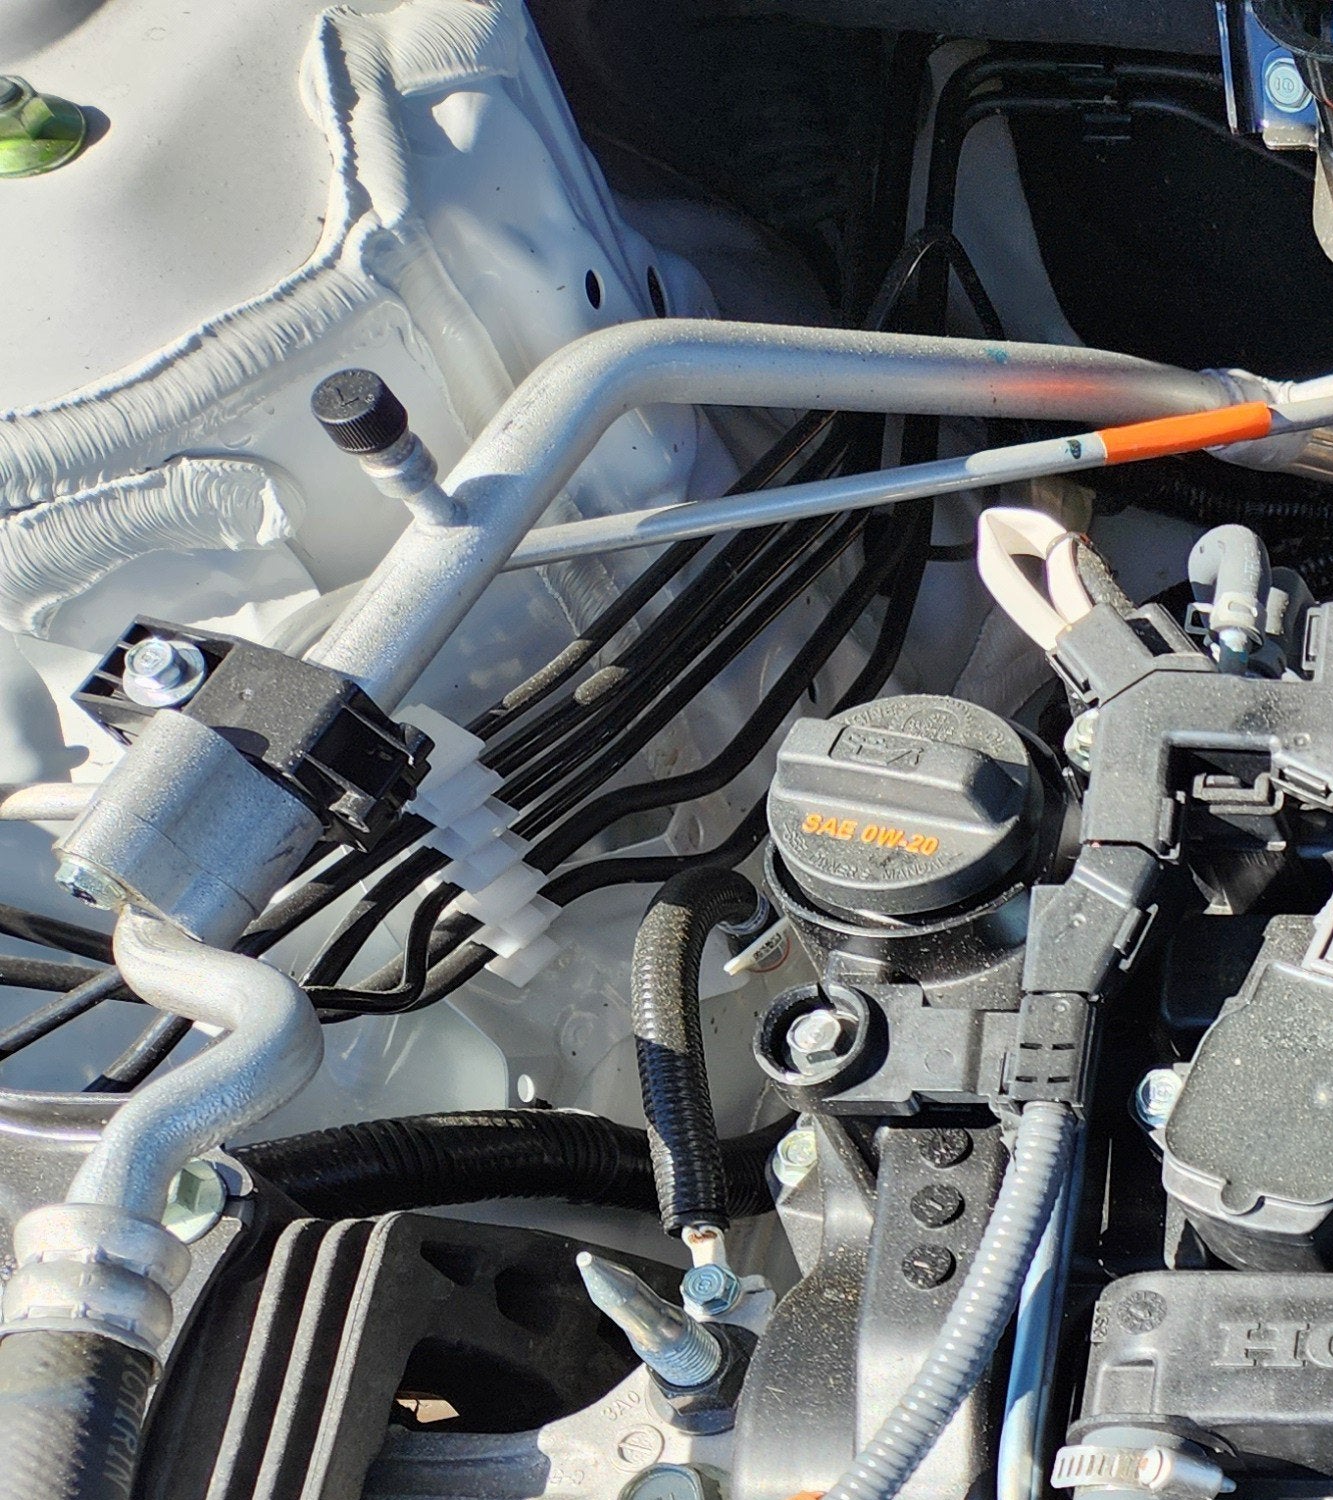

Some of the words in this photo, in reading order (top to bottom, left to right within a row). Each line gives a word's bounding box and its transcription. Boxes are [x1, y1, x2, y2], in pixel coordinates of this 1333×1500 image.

[802, 813, 858, 841] SAE
[860, 824, 940, 857] 0W-20
[102, 1355, 150, 1495] ICHIRIN
